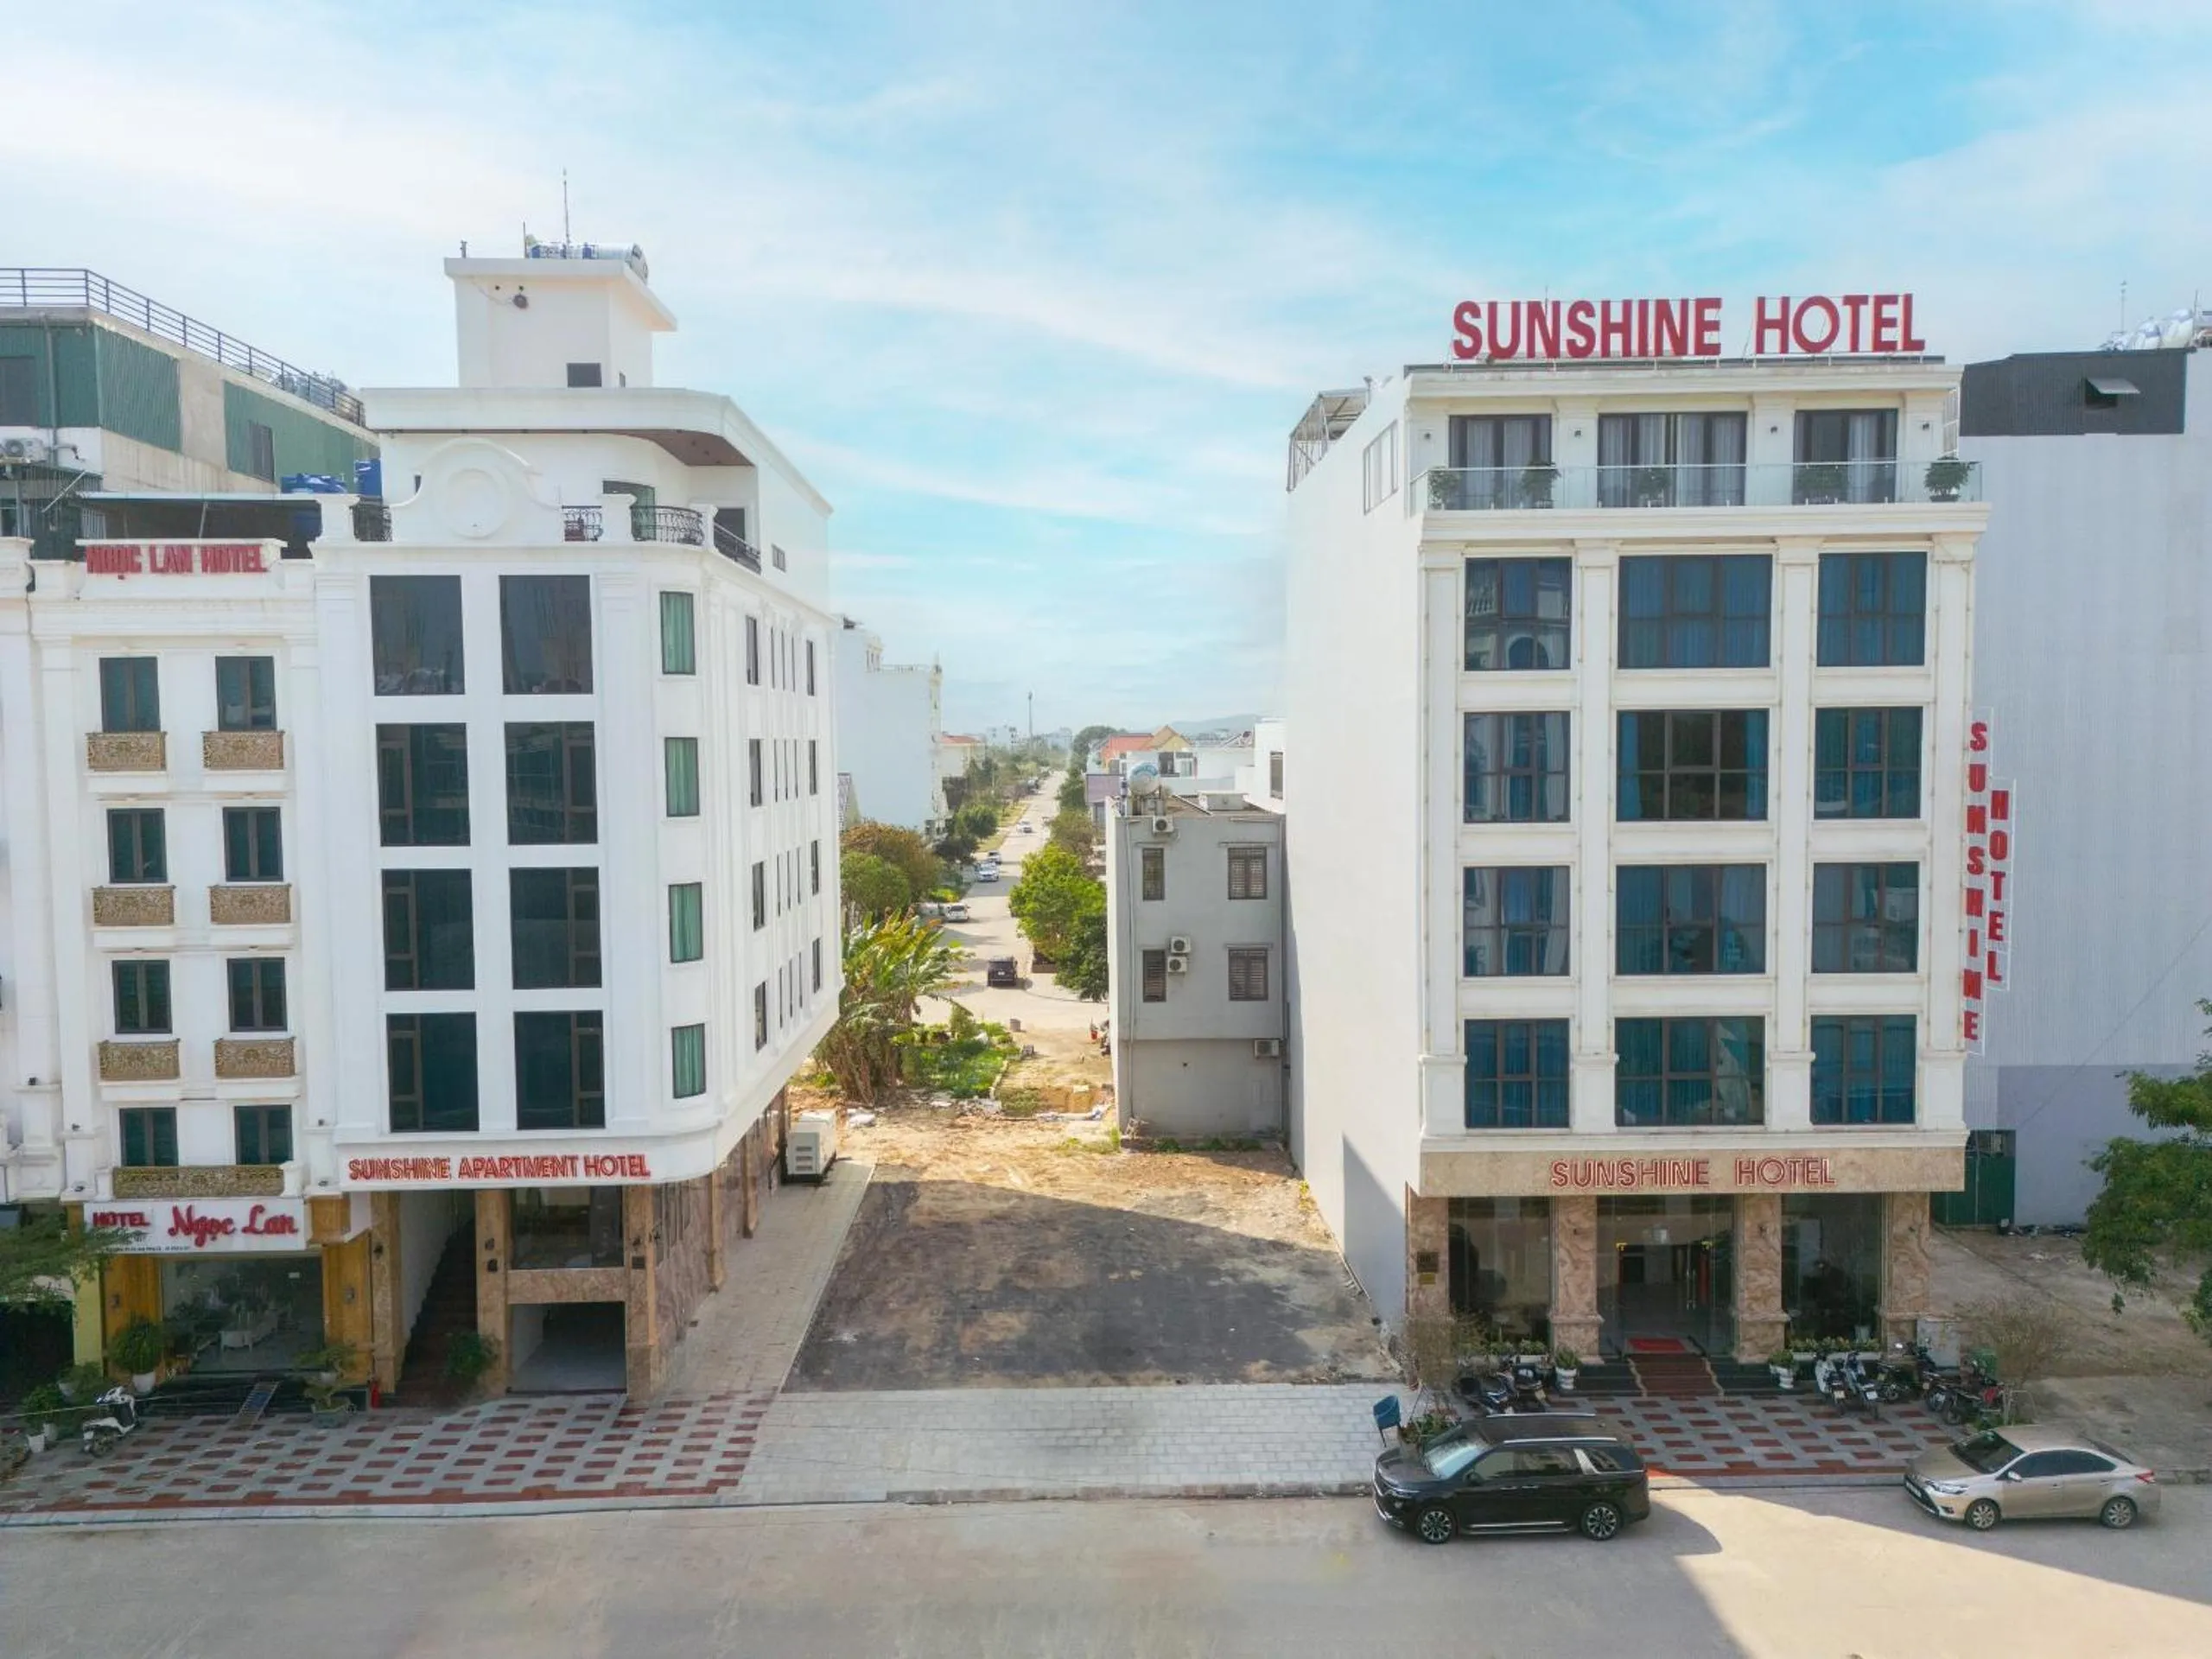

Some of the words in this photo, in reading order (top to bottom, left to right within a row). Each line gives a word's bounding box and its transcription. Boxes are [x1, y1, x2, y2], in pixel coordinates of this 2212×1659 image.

[1452, 297, 1722, 359] SUNSHINE
[1754, 293, 1926, 354] HOTEL
[149, 543, 193, 573] LAN
[201, 543, 270, 573] HOTEL
[1963, 721, 1988, 1040] SUNSHINE
[1986, 790, 2009, 982] HOTEL
[348, 1157, 451, 1180] SUNSHINE
[458, 1155, 578, 1179] APARTMENT
[583, 1154, 651, 1178] HOTEL
[1550, 1158, 1710, 1187] SUNSHINE
[1735, 1157, 1837, 1186] HOTEL
[92, 1211, 151, 1228] HOTEL
[168, 1205, 236, 1247] Ngọc
[242, 1205, 298, 1234] Lan
